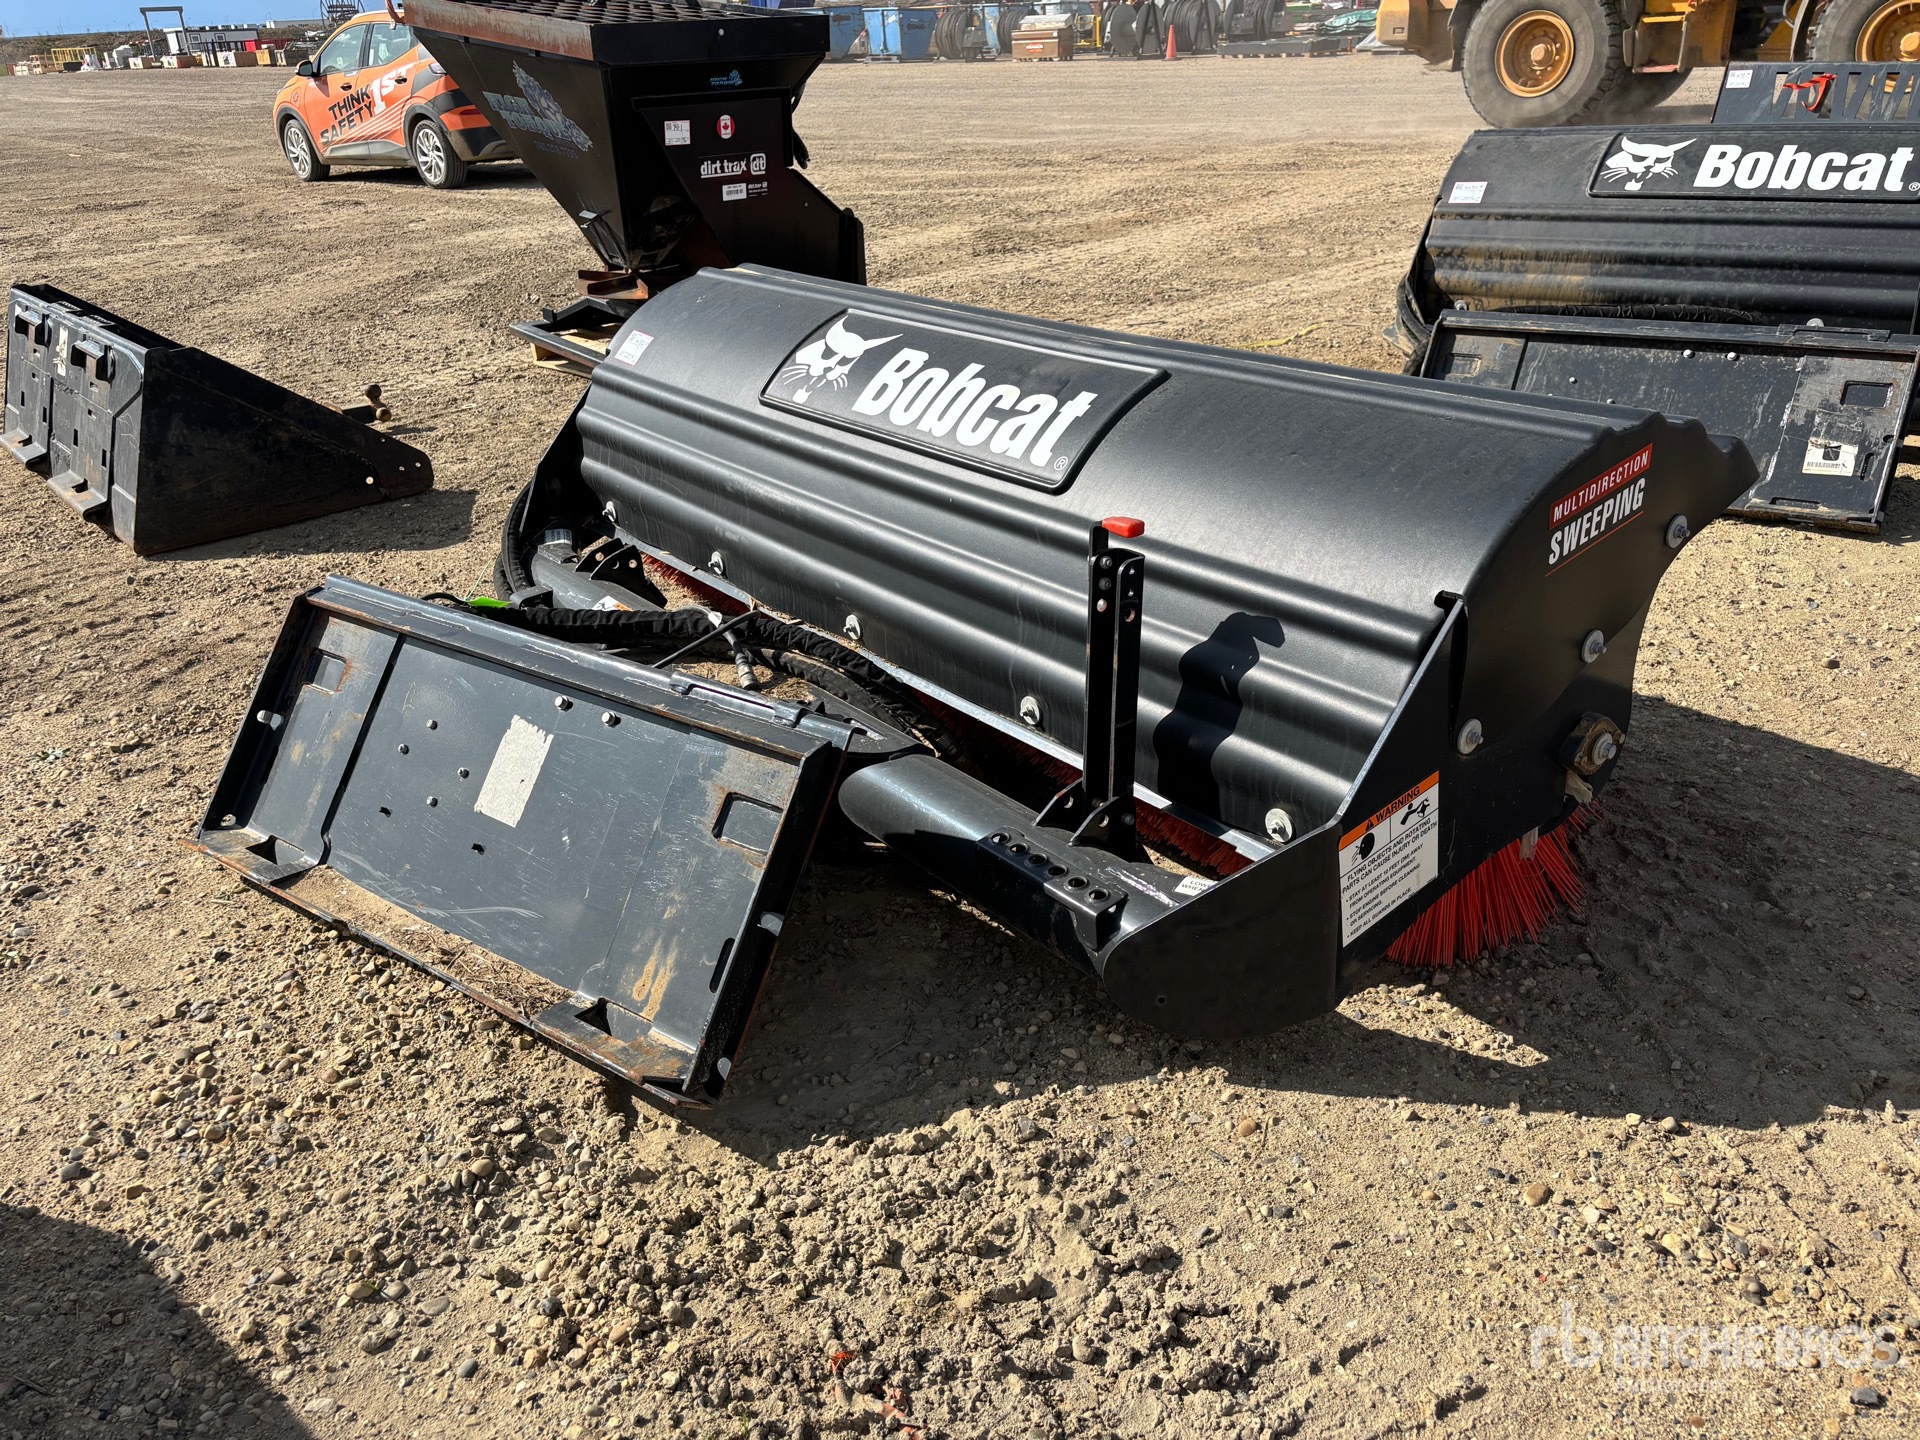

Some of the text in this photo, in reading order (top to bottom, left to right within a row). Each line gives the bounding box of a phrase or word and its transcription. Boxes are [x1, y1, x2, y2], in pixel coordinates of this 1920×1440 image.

[320, 100, 373, 146] SAFETY
[328, 84, 371, 120] THINK
[700, 160, 722, 176] dirt
[723, 157, 747, 176] trax
[1692, 144, 1915, 192] Bobcat
[851, 347, 1098, 467] Bobcat
[1553, 450, 1649, 522] MULTIDIRECTION
[1548, 477, 1645, 565] SWEEPING
[1376, 785, 1420, 823] WARNING
[1342, 820, 1436, 894] PARTS CAN CAUSE INJURY OR DEATH
[1347, 816, 1430, 882] FLYING OBJECTS AND ROTATING
[1349, 888, 1360, 901] STAY
[1361, 883, 1367, 892] AT
[1368, 872, 1382, 887] LEAST
[1388, 859, 1399, 872] FEET
[1362, 892, 1378, 909] ENGINE
[1380, 878, 1397, 896] BEFORE
[1398, 862, 1419, 882] CLEANING
[1363, 875, 1389, 898] OPERATING
